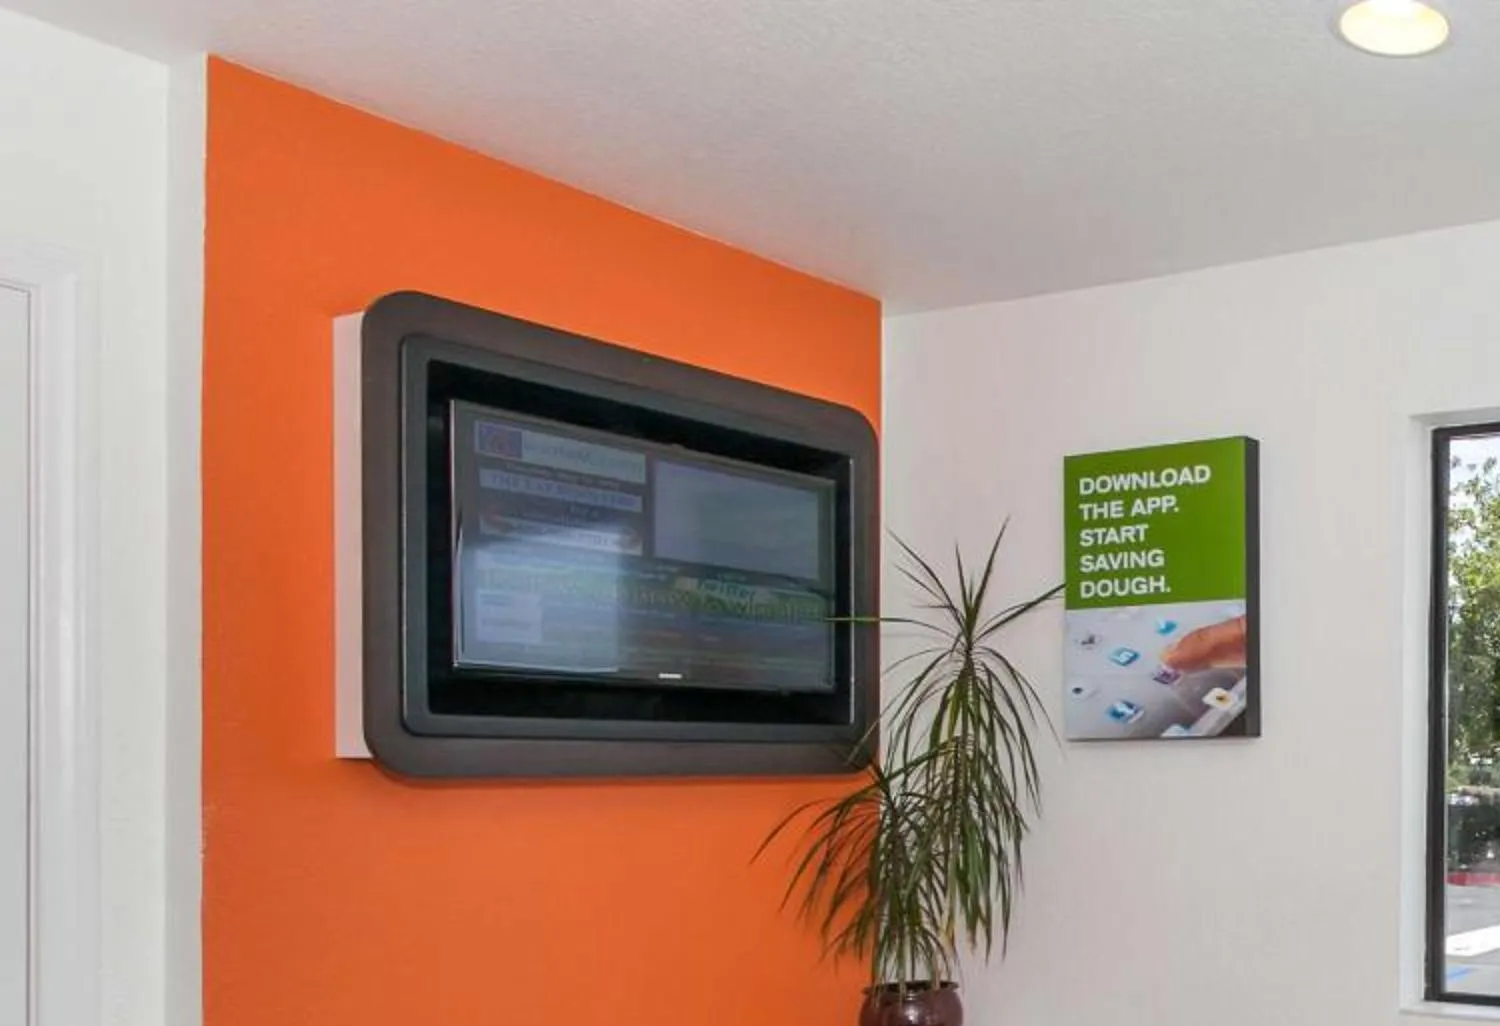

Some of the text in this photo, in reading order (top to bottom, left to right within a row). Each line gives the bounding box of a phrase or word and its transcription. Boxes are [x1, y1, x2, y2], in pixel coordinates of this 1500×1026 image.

[1078, 465, 1211, 495] DOWNLOAD
[1079, 495, 1180, 521] THE APP.
[1079, 523, 1149, 547] START
[1079, 549, 1165, 573] SAVING
[1080, 576, 1172, 599] DOUGH.
